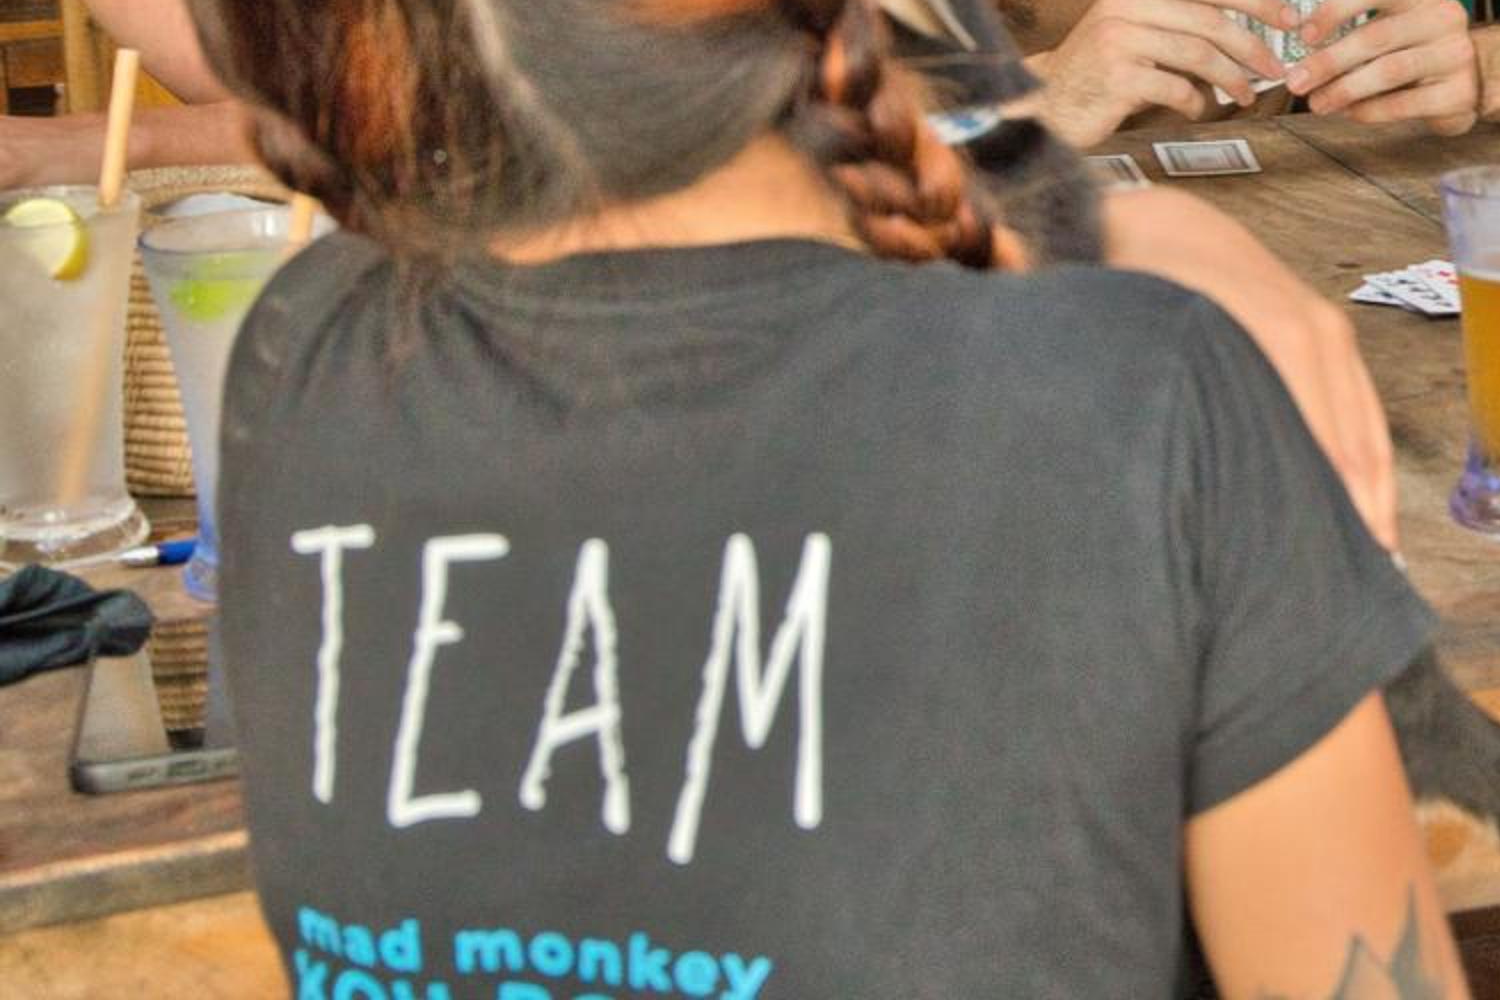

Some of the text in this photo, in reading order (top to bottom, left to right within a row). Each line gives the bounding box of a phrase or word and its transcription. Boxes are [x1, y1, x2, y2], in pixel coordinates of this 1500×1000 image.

[290, 523, 831, 864] TEAM
[296, 905, 423, 972] mad
[453, 928, 772, 1000] monkey
